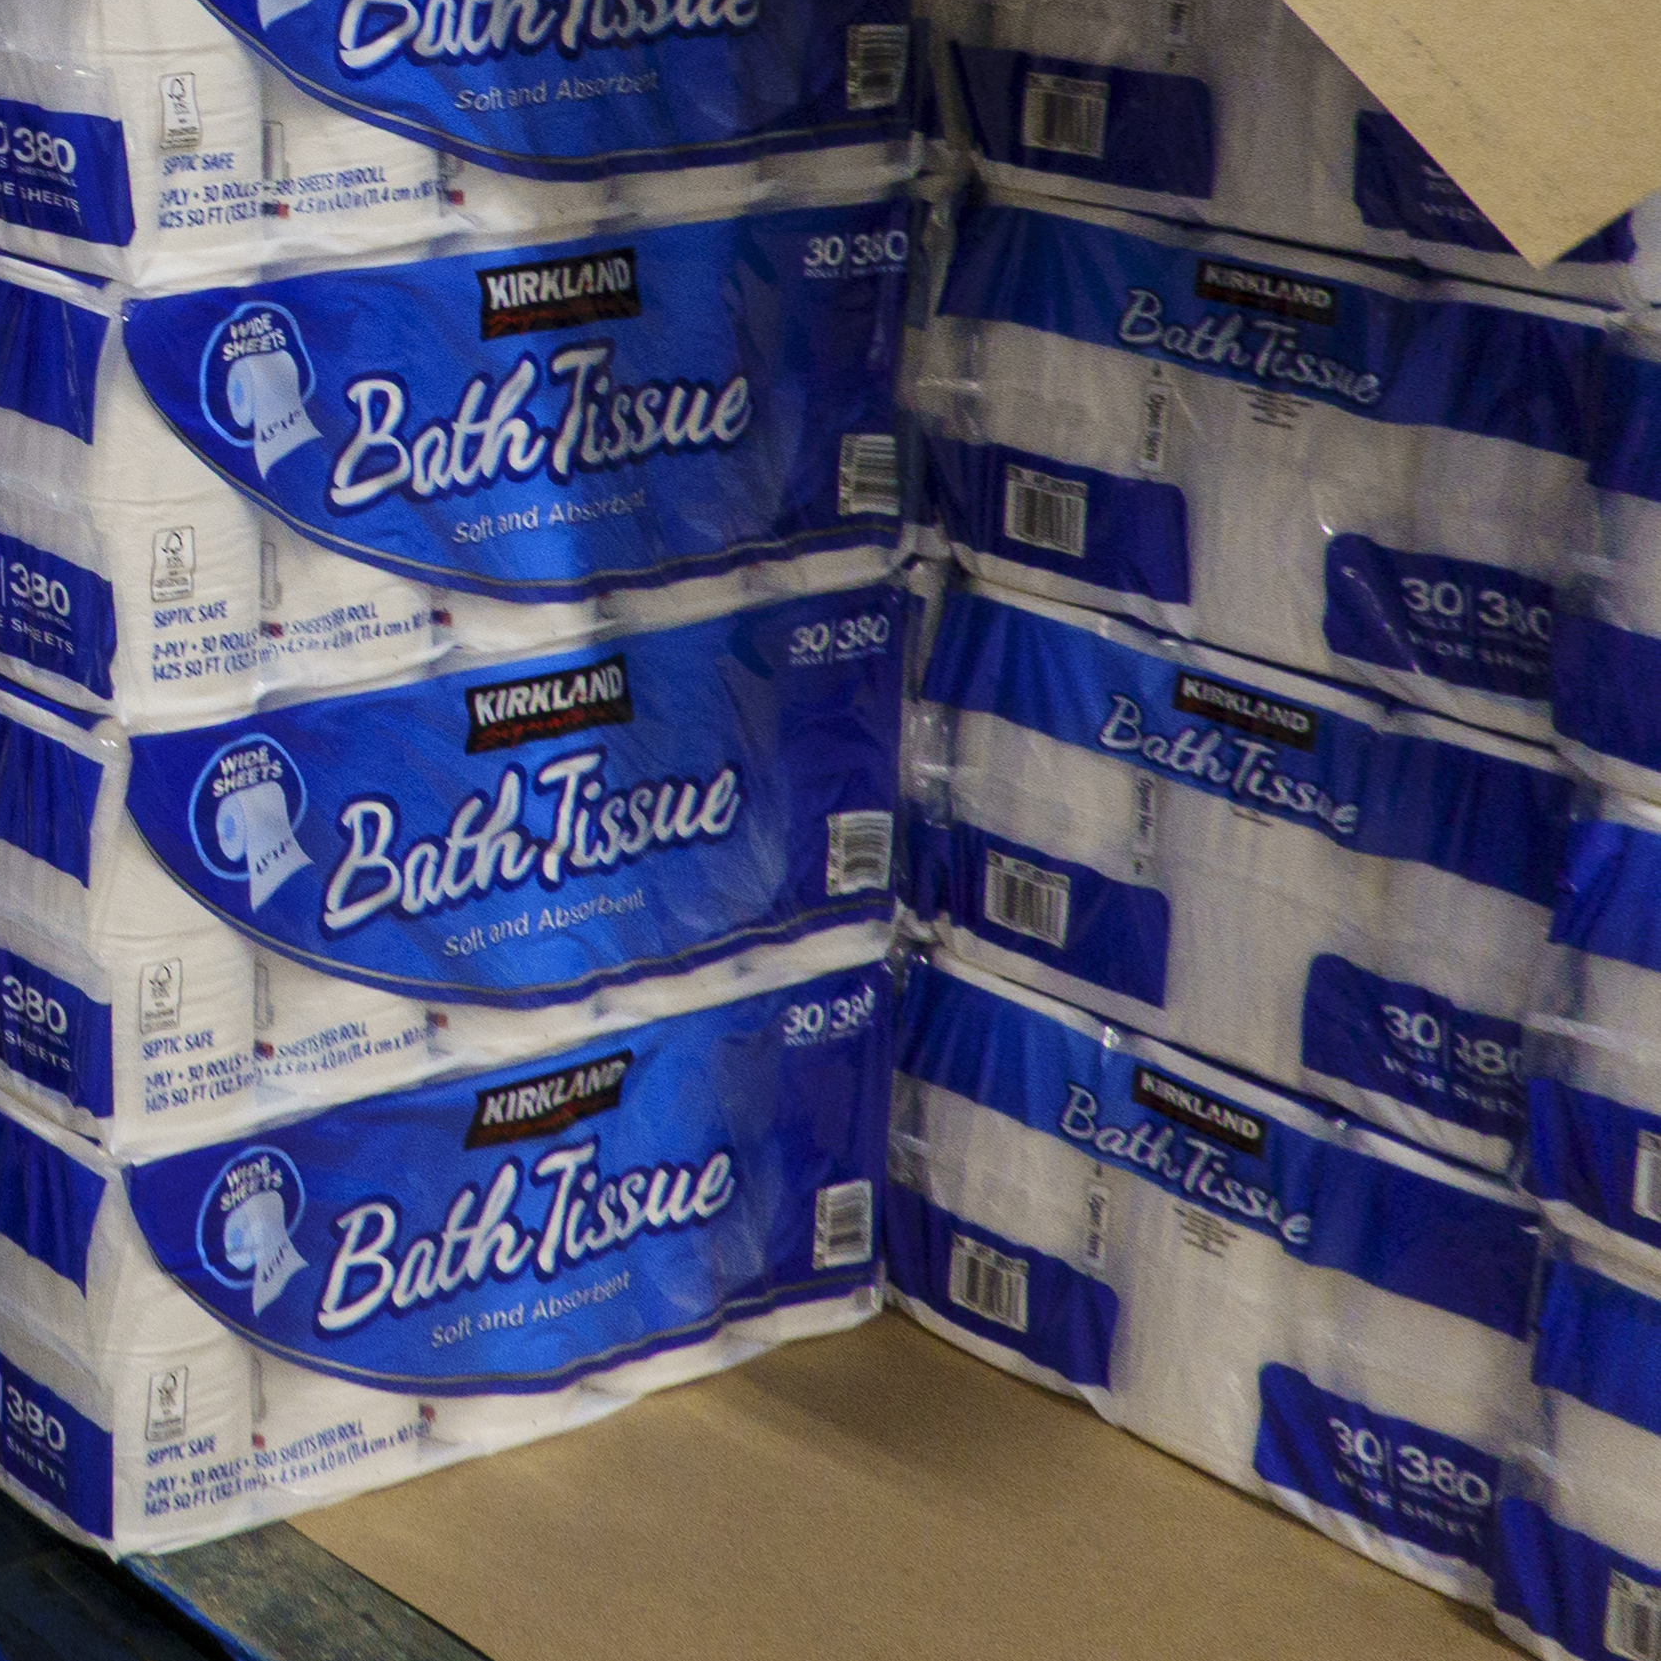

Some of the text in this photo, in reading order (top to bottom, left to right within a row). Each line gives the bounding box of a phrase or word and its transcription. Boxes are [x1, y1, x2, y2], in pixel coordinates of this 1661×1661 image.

[487, 258, 631, 311] KIRKLAND
[1205, 265, 1331, 308] KIRKLAND
[331, 348, 750, 506] Bath Tissue
[474, 668, 624, 728] KIRKLAND
[1181, 677, 1311, 734] KIRKLAND
[323, 754, 741, 929] Bath Tissue
[482, 1061, 627, 1128] KIRKLAND
[1140, 1072, 1261, 1140] KIRKLAND
[317, 1145, 734, 1329] Bath Tissue
